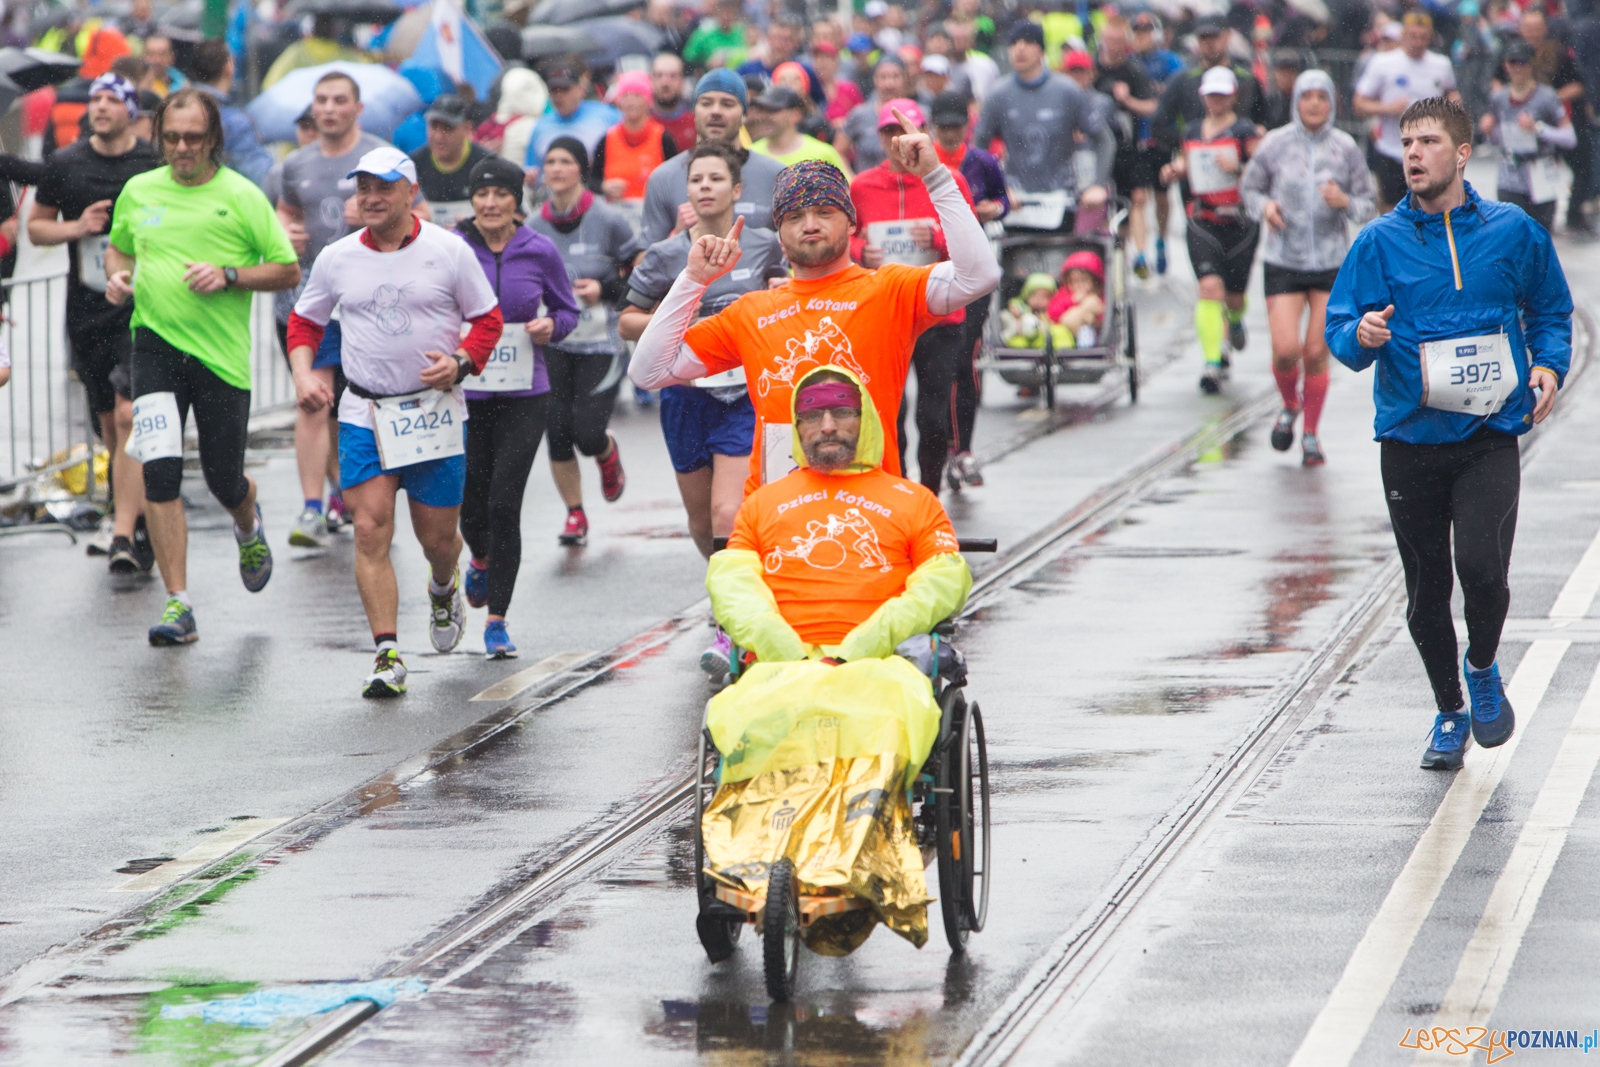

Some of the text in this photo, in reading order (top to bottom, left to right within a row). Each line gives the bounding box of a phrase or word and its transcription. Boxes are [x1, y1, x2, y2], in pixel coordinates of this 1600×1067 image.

[757, 298, 858, 329] Dzieci Kotana
[1450, 361, 1502, 385] 3973
[390, 409, 454, 437] 12424
[776, 489, 893, 518] Dzieci Kotana
